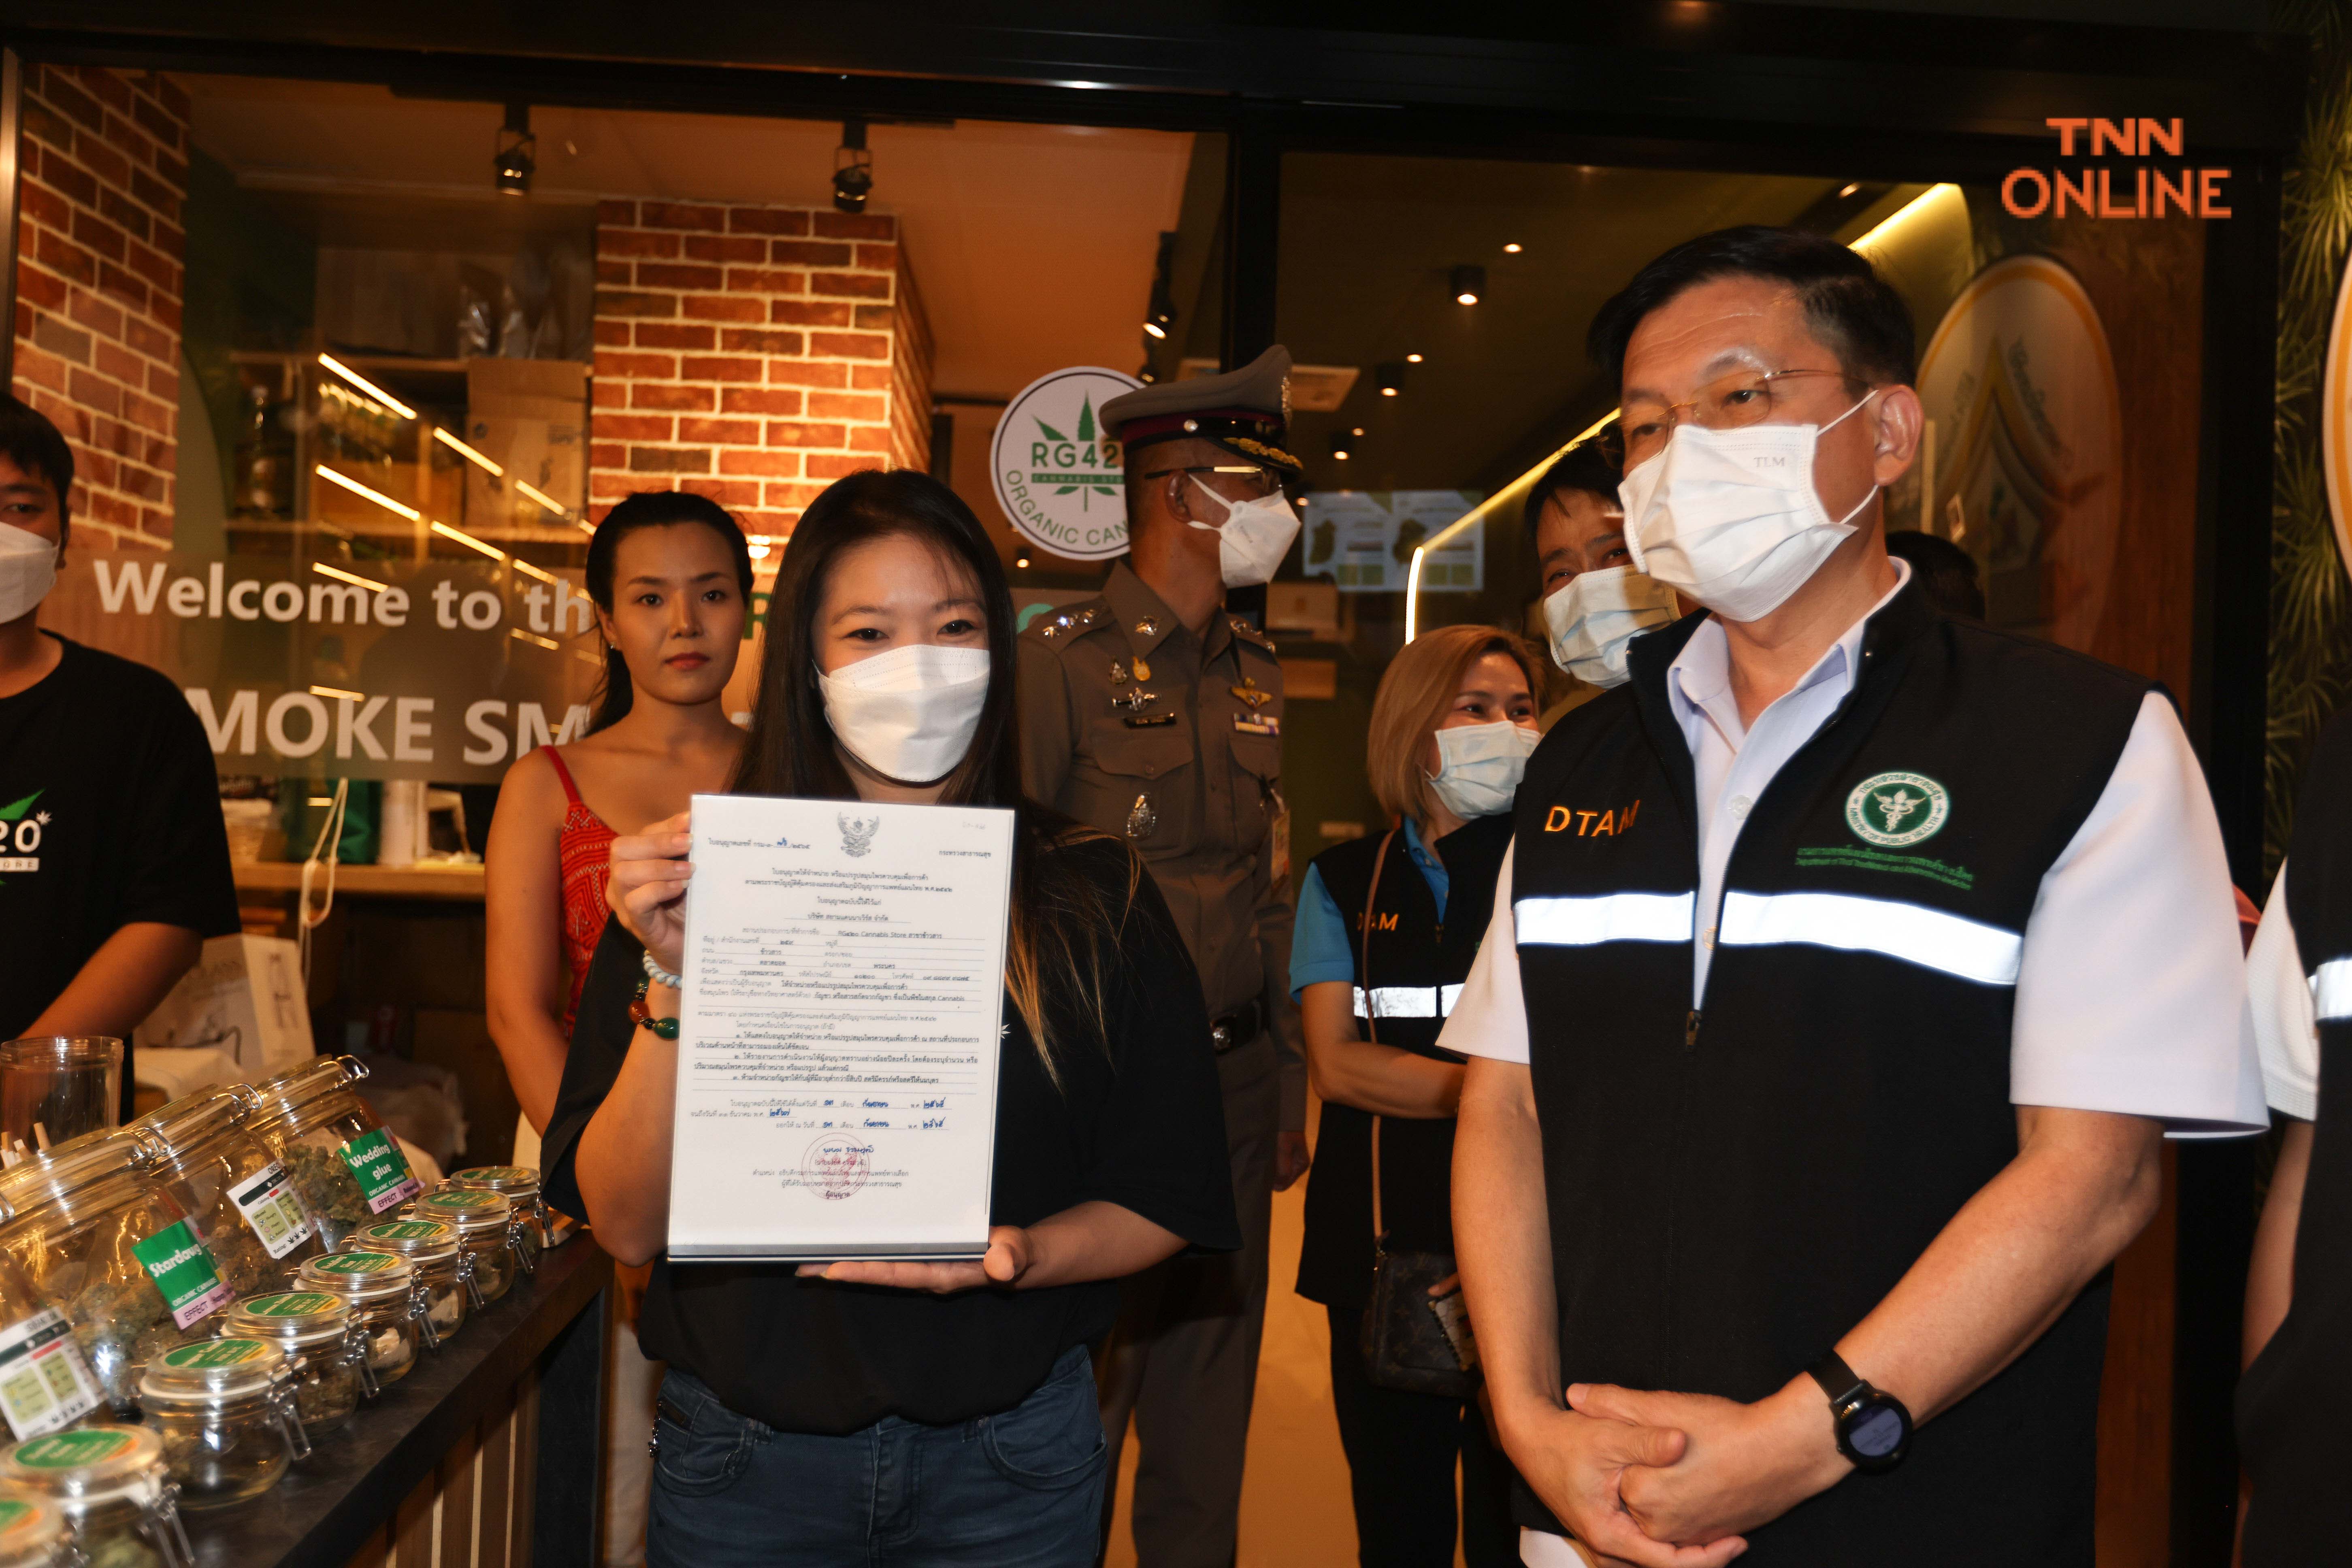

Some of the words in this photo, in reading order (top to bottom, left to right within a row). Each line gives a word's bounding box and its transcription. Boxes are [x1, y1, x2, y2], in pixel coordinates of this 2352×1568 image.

[1754, 456, 1785, 467] TLM
[1006, 470, 1079, 544] ORGANIC
[94, 559, 410, 627] Welcome
[431, 579, 502, 631] to
[1544, 799, 1641, 837] DTAM
[939, 850, 992, 858] กระทรวงสาธารณสุข
[349, 1144, 391, 1168] Wedding
[372, 1163, 392, 1181] glue
[377, 1192, 398, 1208] EFFECT
[148, 1243, 203, 1278] Stardawg
[183, 1300, 209, 1321] EFFECT
